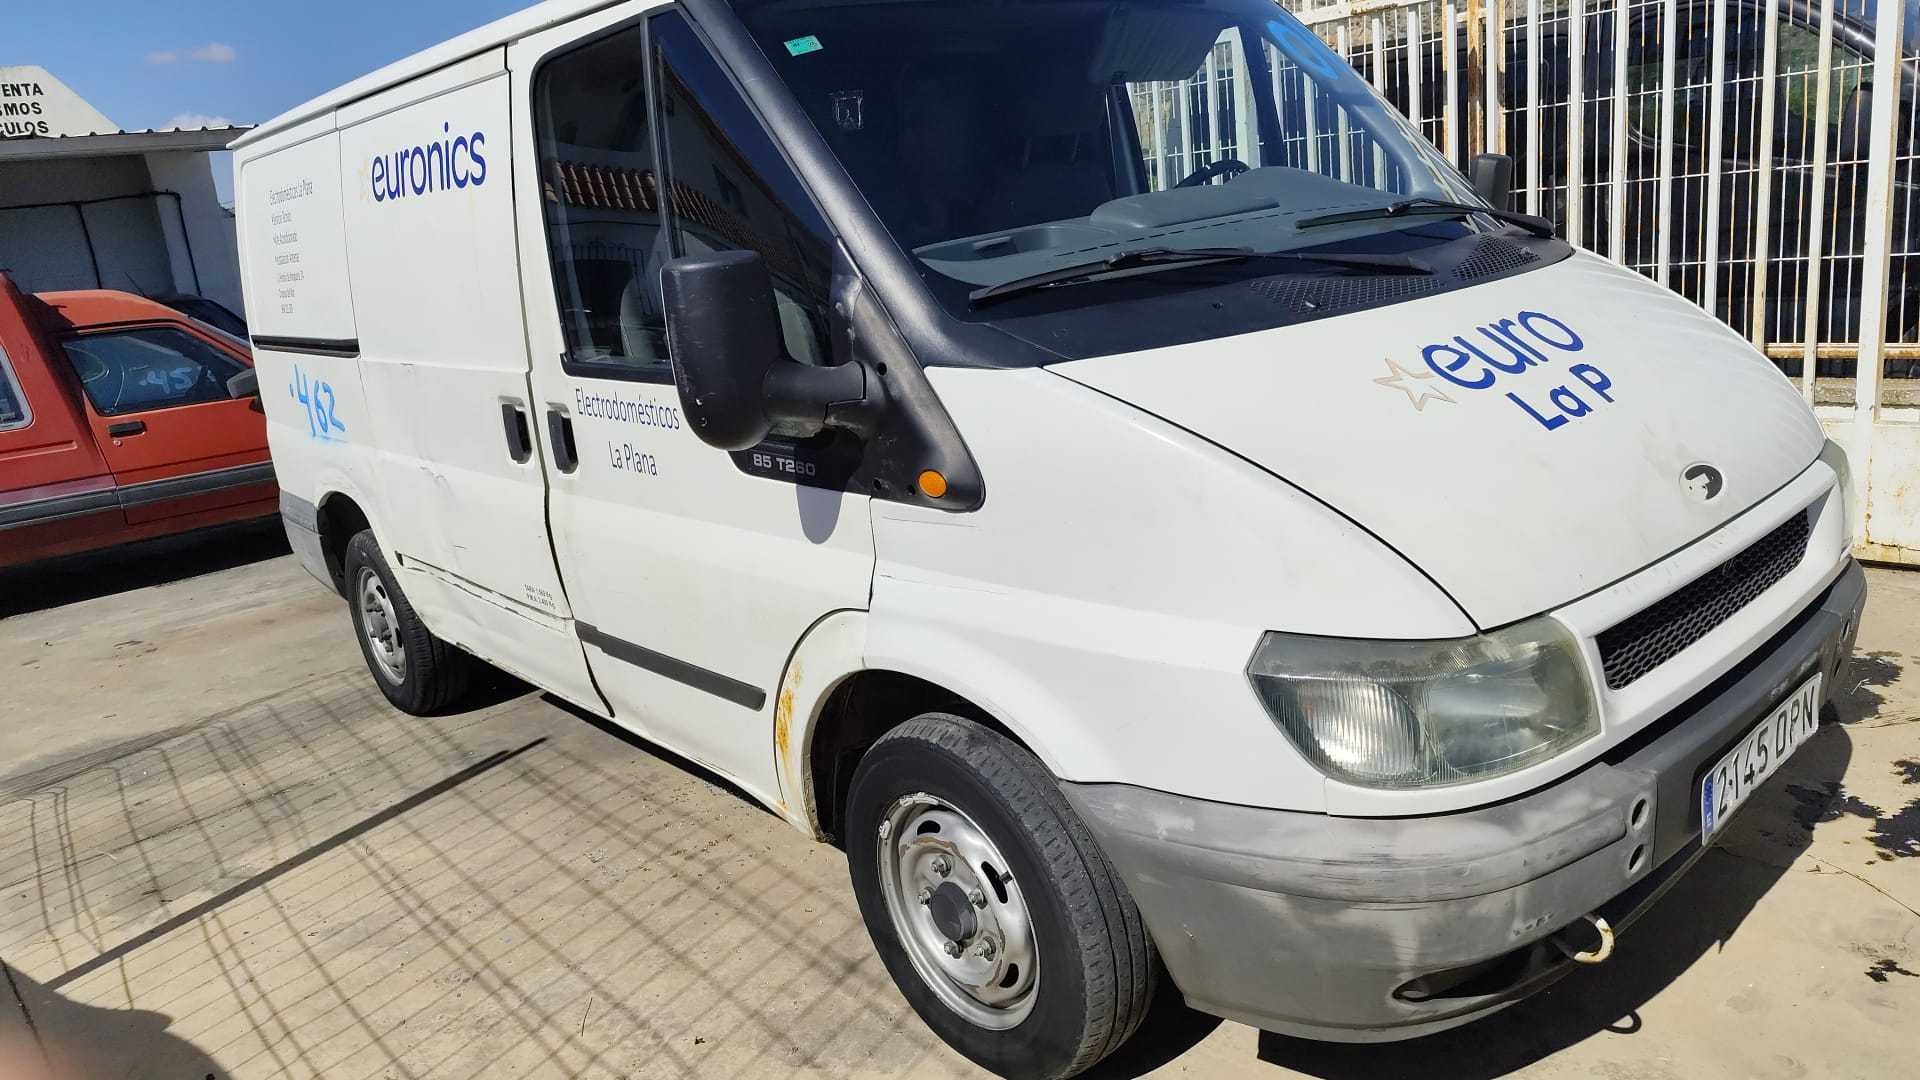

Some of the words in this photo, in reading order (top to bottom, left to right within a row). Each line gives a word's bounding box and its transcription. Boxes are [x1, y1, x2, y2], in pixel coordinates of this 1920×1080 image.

[0, 101, 42, 116] MOS
[371, 121, 487, 202] euronics
[1422, 310, 1584, 390] euro
[575, 386, 680, 431] Electrodomésticos
[1505, 384, 1594, 431] La
[1568, 363, 1616, 404] P
[608, 440, 623, 469] La
[623, 442, 658, 476] Plana
[753, 453, 772, 469] 85
[775, 457, 816, 477] T260
[1717, 725, 1769, 819] 2145
